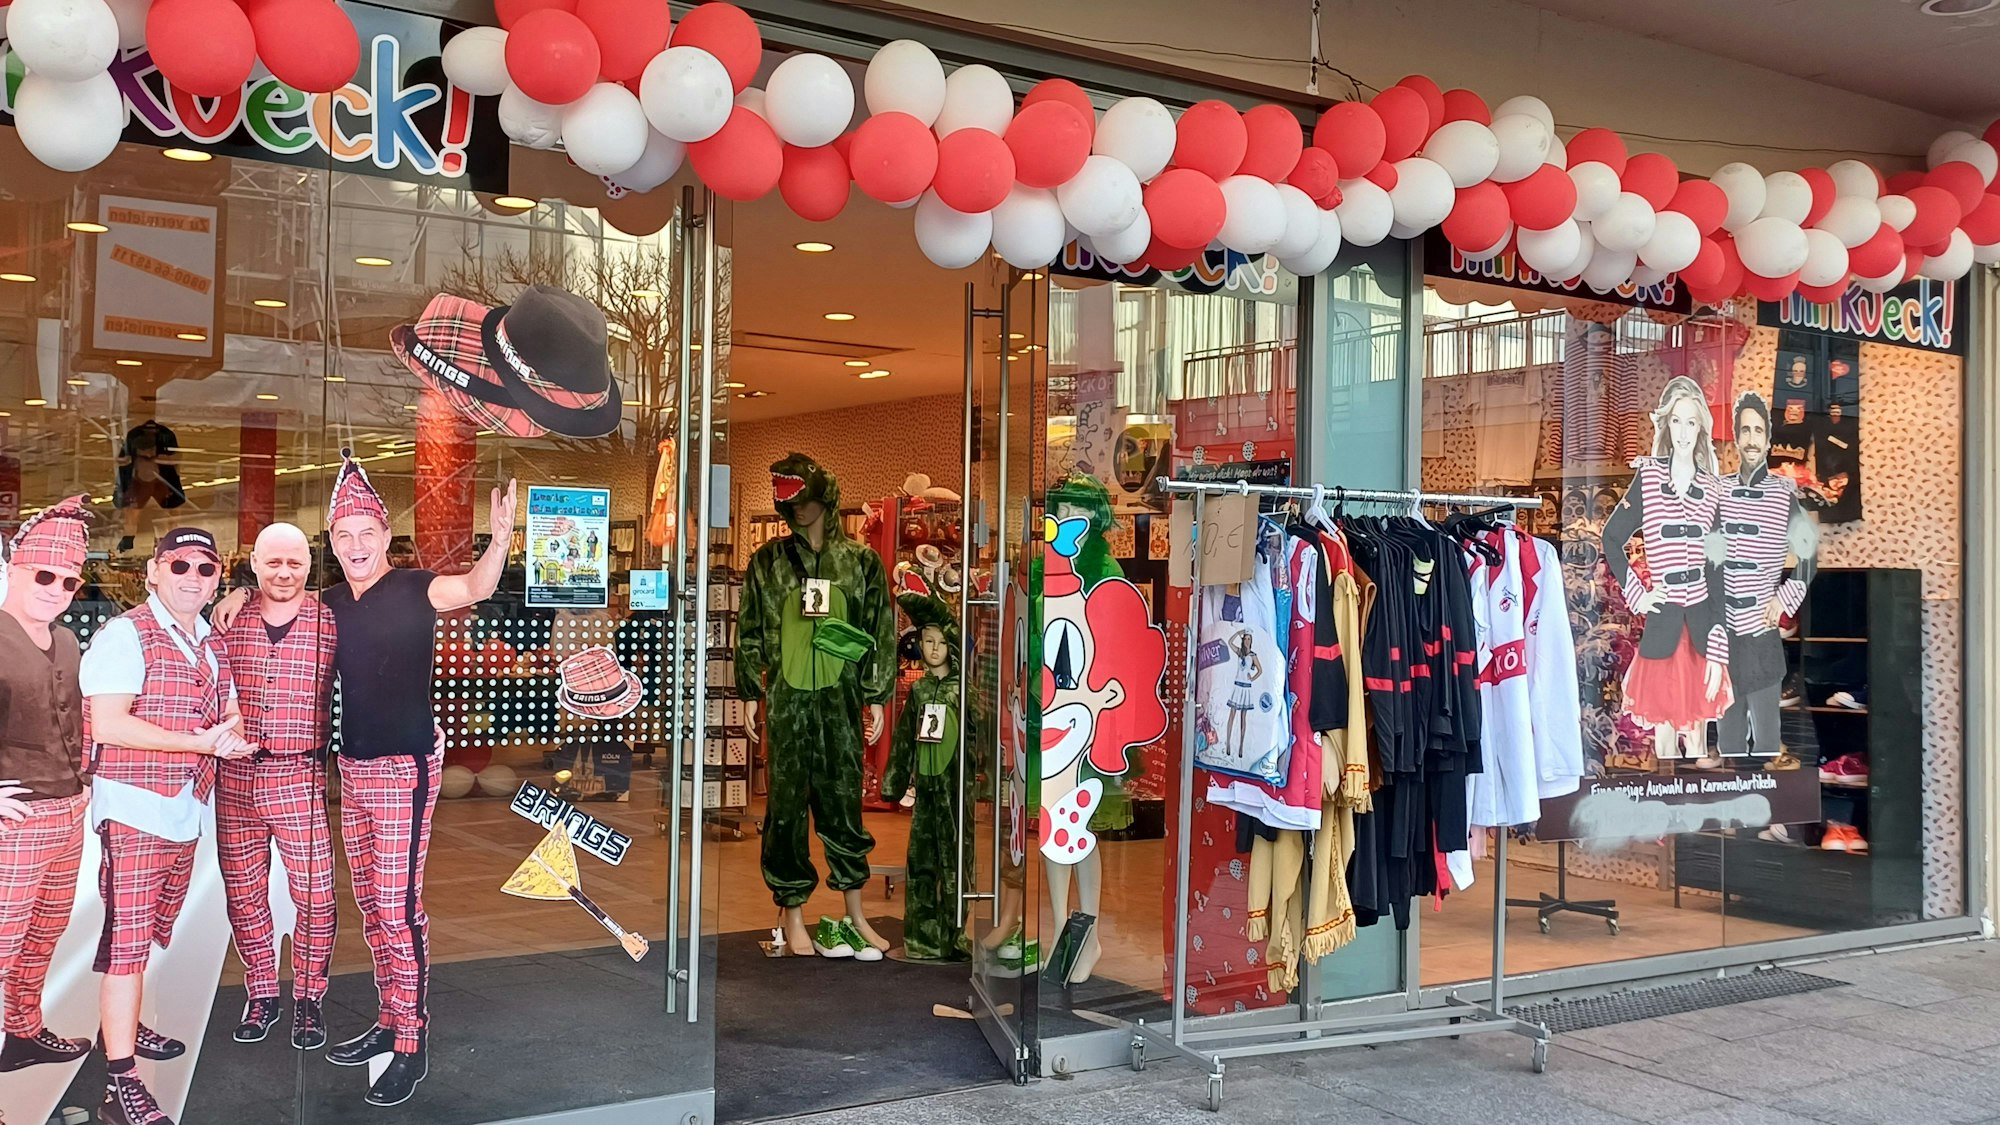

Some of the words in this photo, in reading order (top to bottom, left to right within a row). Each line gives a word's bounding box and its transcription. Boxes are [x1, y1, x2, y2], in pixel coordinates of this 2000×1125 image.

[412, 342, 471, 388] BRINGS
[572, 693, 607, 702] BRINGS
[601, 752, 621, 760] KÖLN
[1646, 777, 1684, 798] Auswahl
[1685, 783, 1699, 794] an
[1700, 773, 1778, 794] Karnevalsartikeln
[511, 781, 632, 864] BRINGS
